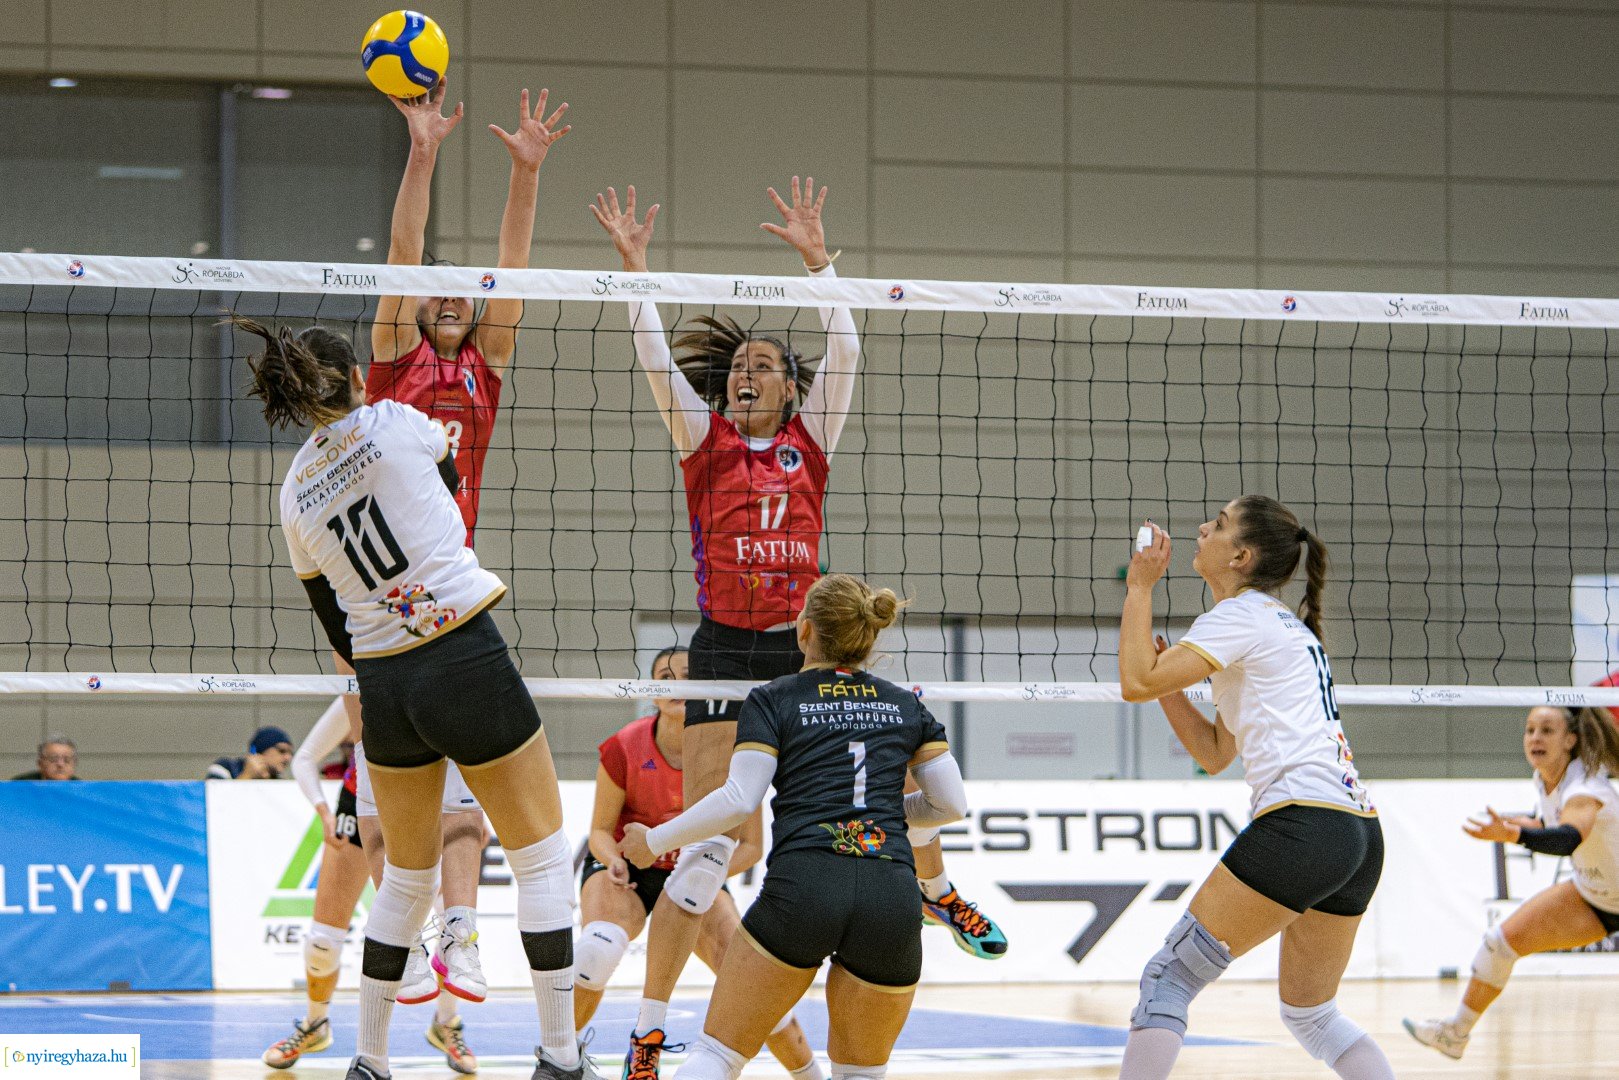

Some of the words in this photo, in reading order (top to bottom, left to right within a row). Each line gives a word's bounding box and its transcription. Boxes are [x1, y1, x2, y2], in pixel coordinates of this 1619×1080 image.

[202, 269, 245, 279] RÖPLABDA
[321, 268, 377, 286] FATUM
[621, 281, 662, 291] RÖPLABDA
[733, 280, 785, 298] FATUM
[1137, 292, 1187, 309] FATUM
[1519, 301, 1569, 318] FATUM
[296, 425, 365, 484] VESOVIC
[326, 440, 376, 480] BENEDEK
[300, 450, 382, 514] BALATONFÜRED
[757, 493, 788, 530] 17
[327, 493, 409, 592] 10
[734, 536, 810, 561] FATUM
[818, 680, 878, 698] FÁTH
[706, 699, 728, 715] 17
[799, 702, 841, 713] SZENT
[843, 700, 900, 713] BENEDEK
[801, 711, 903, 726] BALATONFÜRED
[829, 721, 883, 731] röplabda
[848, 741, 867, 808] 1
[336, 813, 356, 837] 16
[0, 863, 184, 914] LEY.TV
